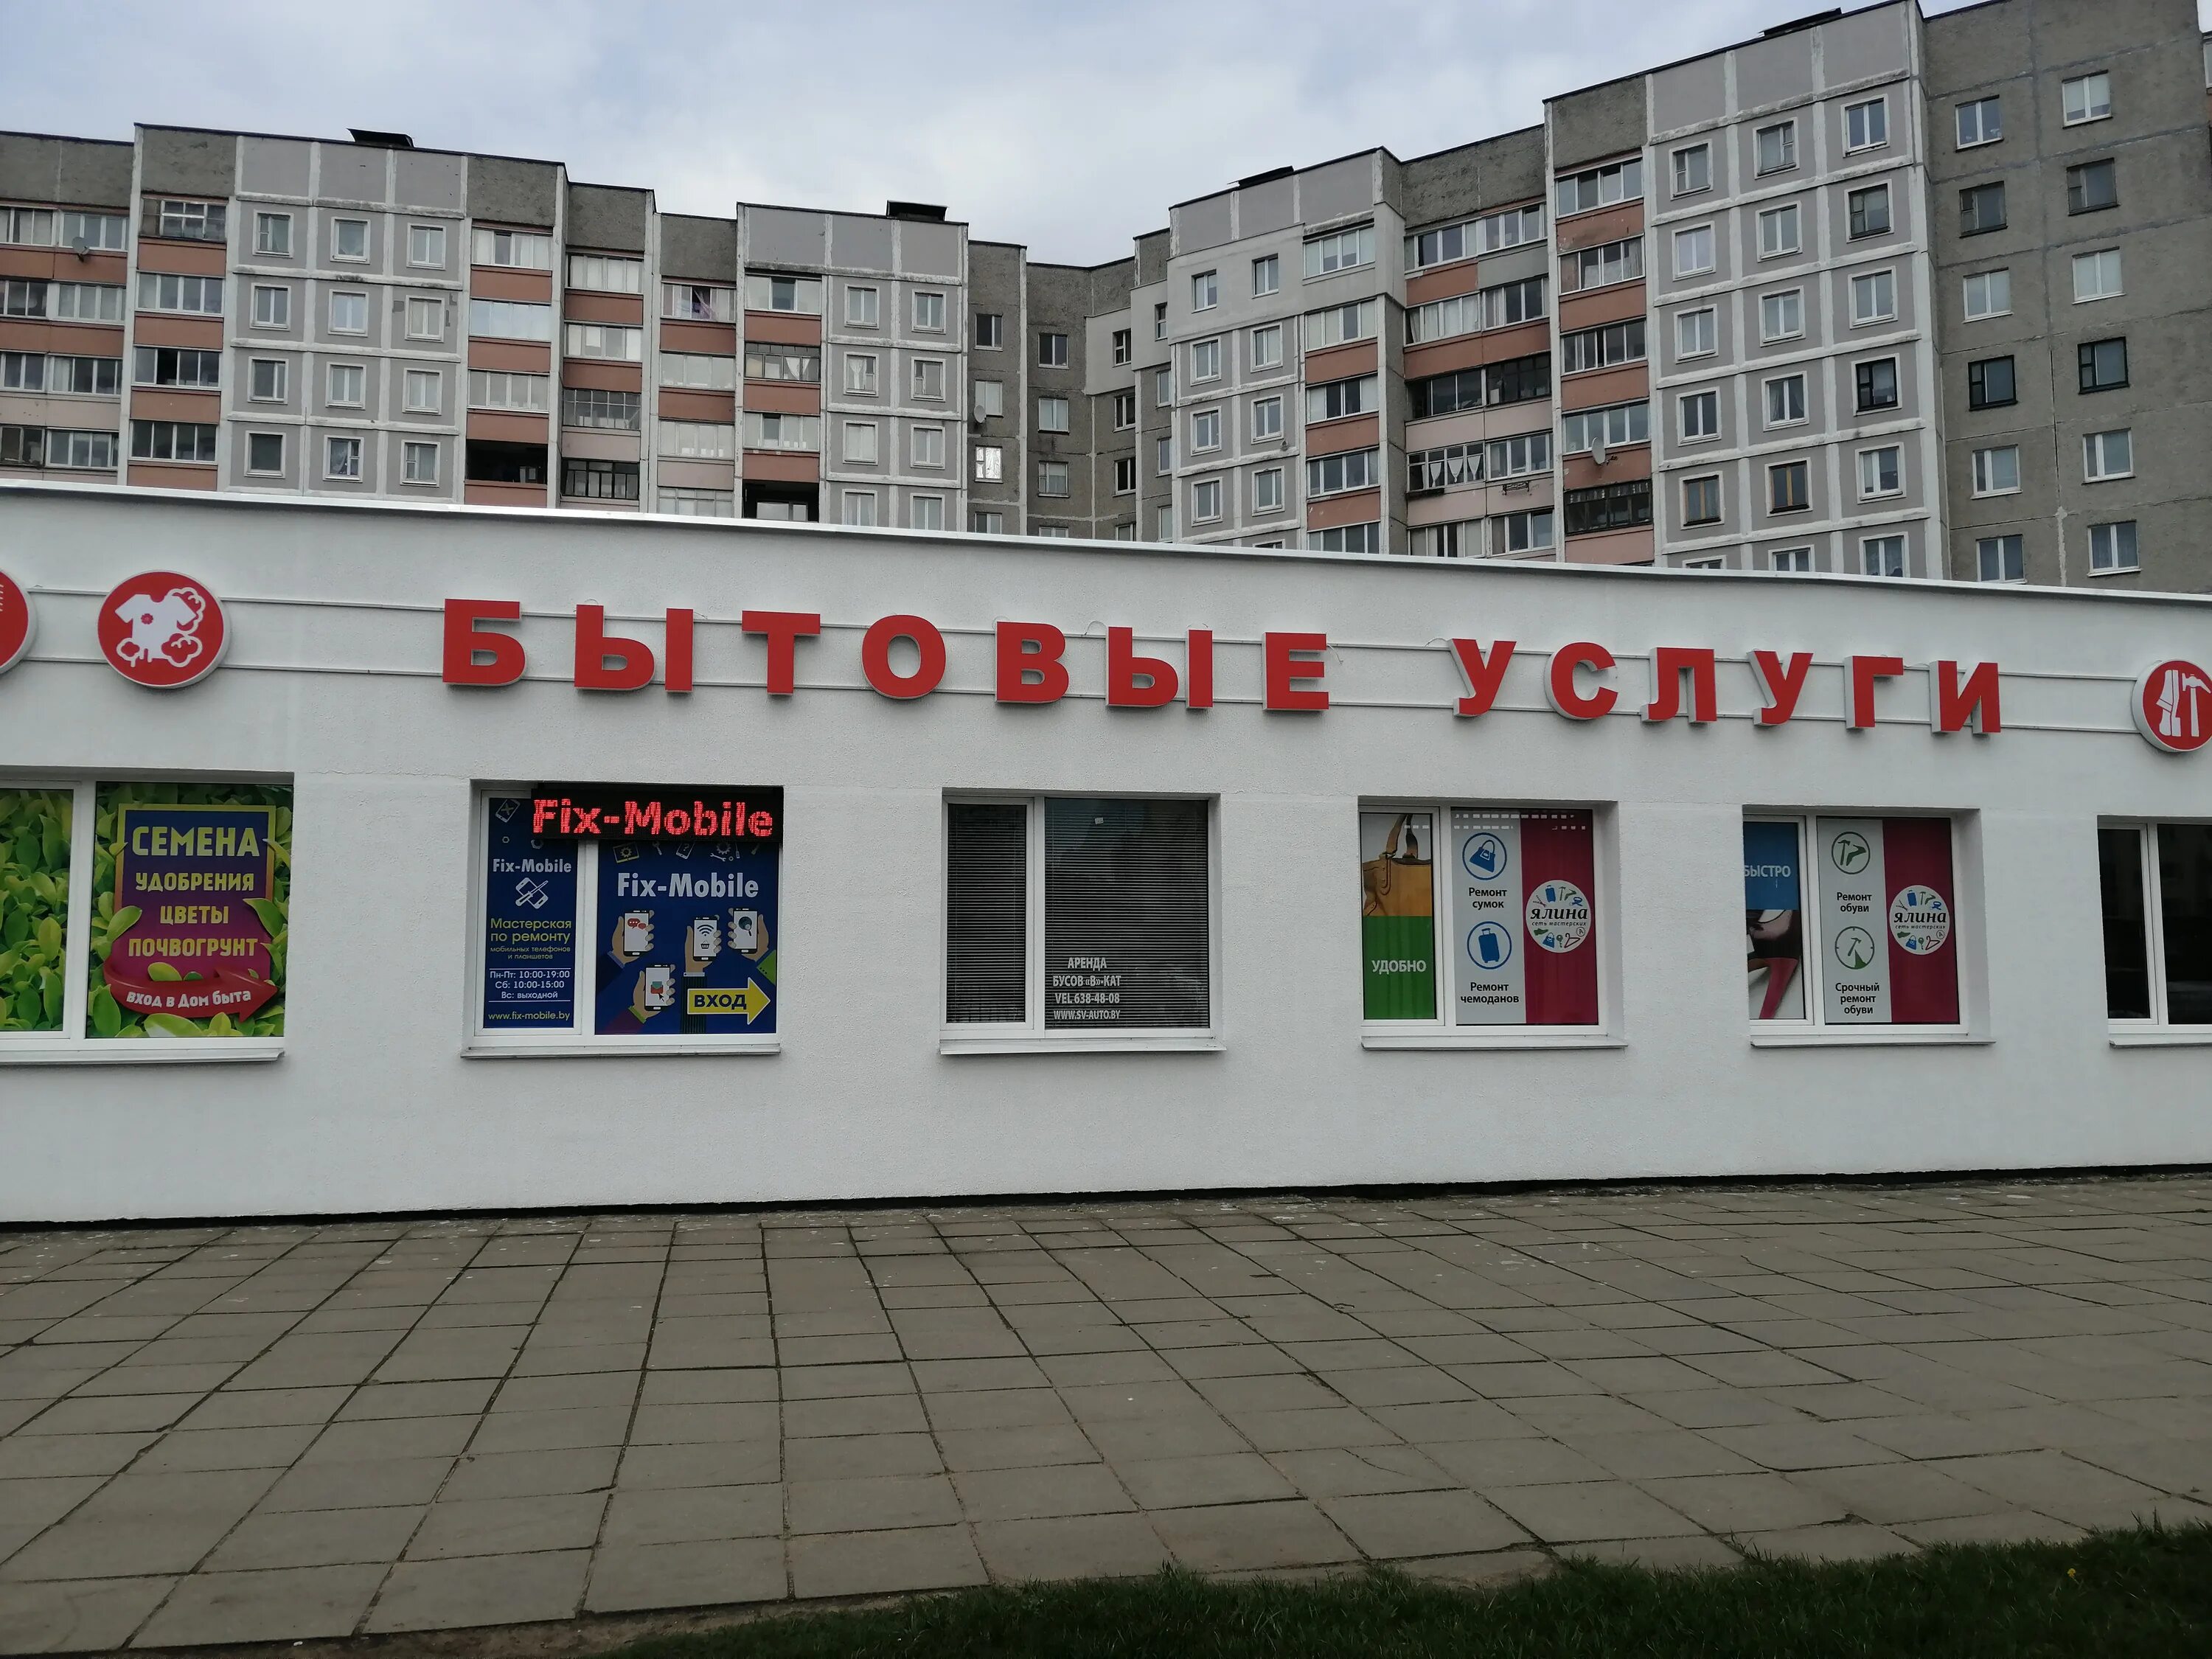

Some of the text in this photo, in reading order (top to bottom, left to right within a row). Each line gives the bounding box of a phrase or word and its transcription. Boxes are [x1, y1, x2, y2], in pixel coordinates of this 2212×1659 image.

[442, 598, 2001, 735] БЫТОВЫЕ УСЛУГИ
[532, 798, 773, 837] Fix-Mobile
[132, 826, 260, 857] СЕМЕНА
[493, 858, 572, 874] Fix-Mobile
[1744, 864, 1791, 877] БЫСТРО
[135, 872, 254, 892] УДОБРЕНИЯ
[617, 872, 759, 899] Fix-Mobile
[1468, 887, 1508, 897] Ремонт
[1836, 891, 1872, 901] Ремонт
[1472, 900, 1505, 910] сумок
[1840, 902, 1870, 914] обуви
[160, 905, 229, 926] ЦВЕТЫ
[490, 917, 572, 931] Мастерская
[490, 933, 571, 945] по ремонту
[128, 938, 258, 957] ПОЧВОГРУНТ
[531, 945, 571, 954] телефонов
[1067, 957, 1107, 971] АРЕНДА
[1371, 959, 1427, 975] УДОБНО
[490, 970, 571, 978] Пн-Пт: 10:00-19:00
[495, 981, 565, 989] Сб: 10:00-15:00
[1053, 975, 1084, 987] БУСОВ
[1470, 981, 1509, 992] Ремонт
[1835, 982, 1880, 994] Срочный
[178, 994, 209, 1009] Дом
[212, 990, 251, 1005] быта
[517, 990, 559, 999] выходной
[1055, 992, 1120, 1004] VEL 638-48-08
[1460, 995, 1520, 1005] чемоданов
[1840, 995, 1877, 1006] ремонт
[693, 993, 748, 1010] ВХОД
[487, 1011, 571, 1021] www.fix-mobile.by
[1054, 1009, 1121, 1020] WWW.SV-AUTO.BY
[1844, 1004, 1874, 1016] обуви
